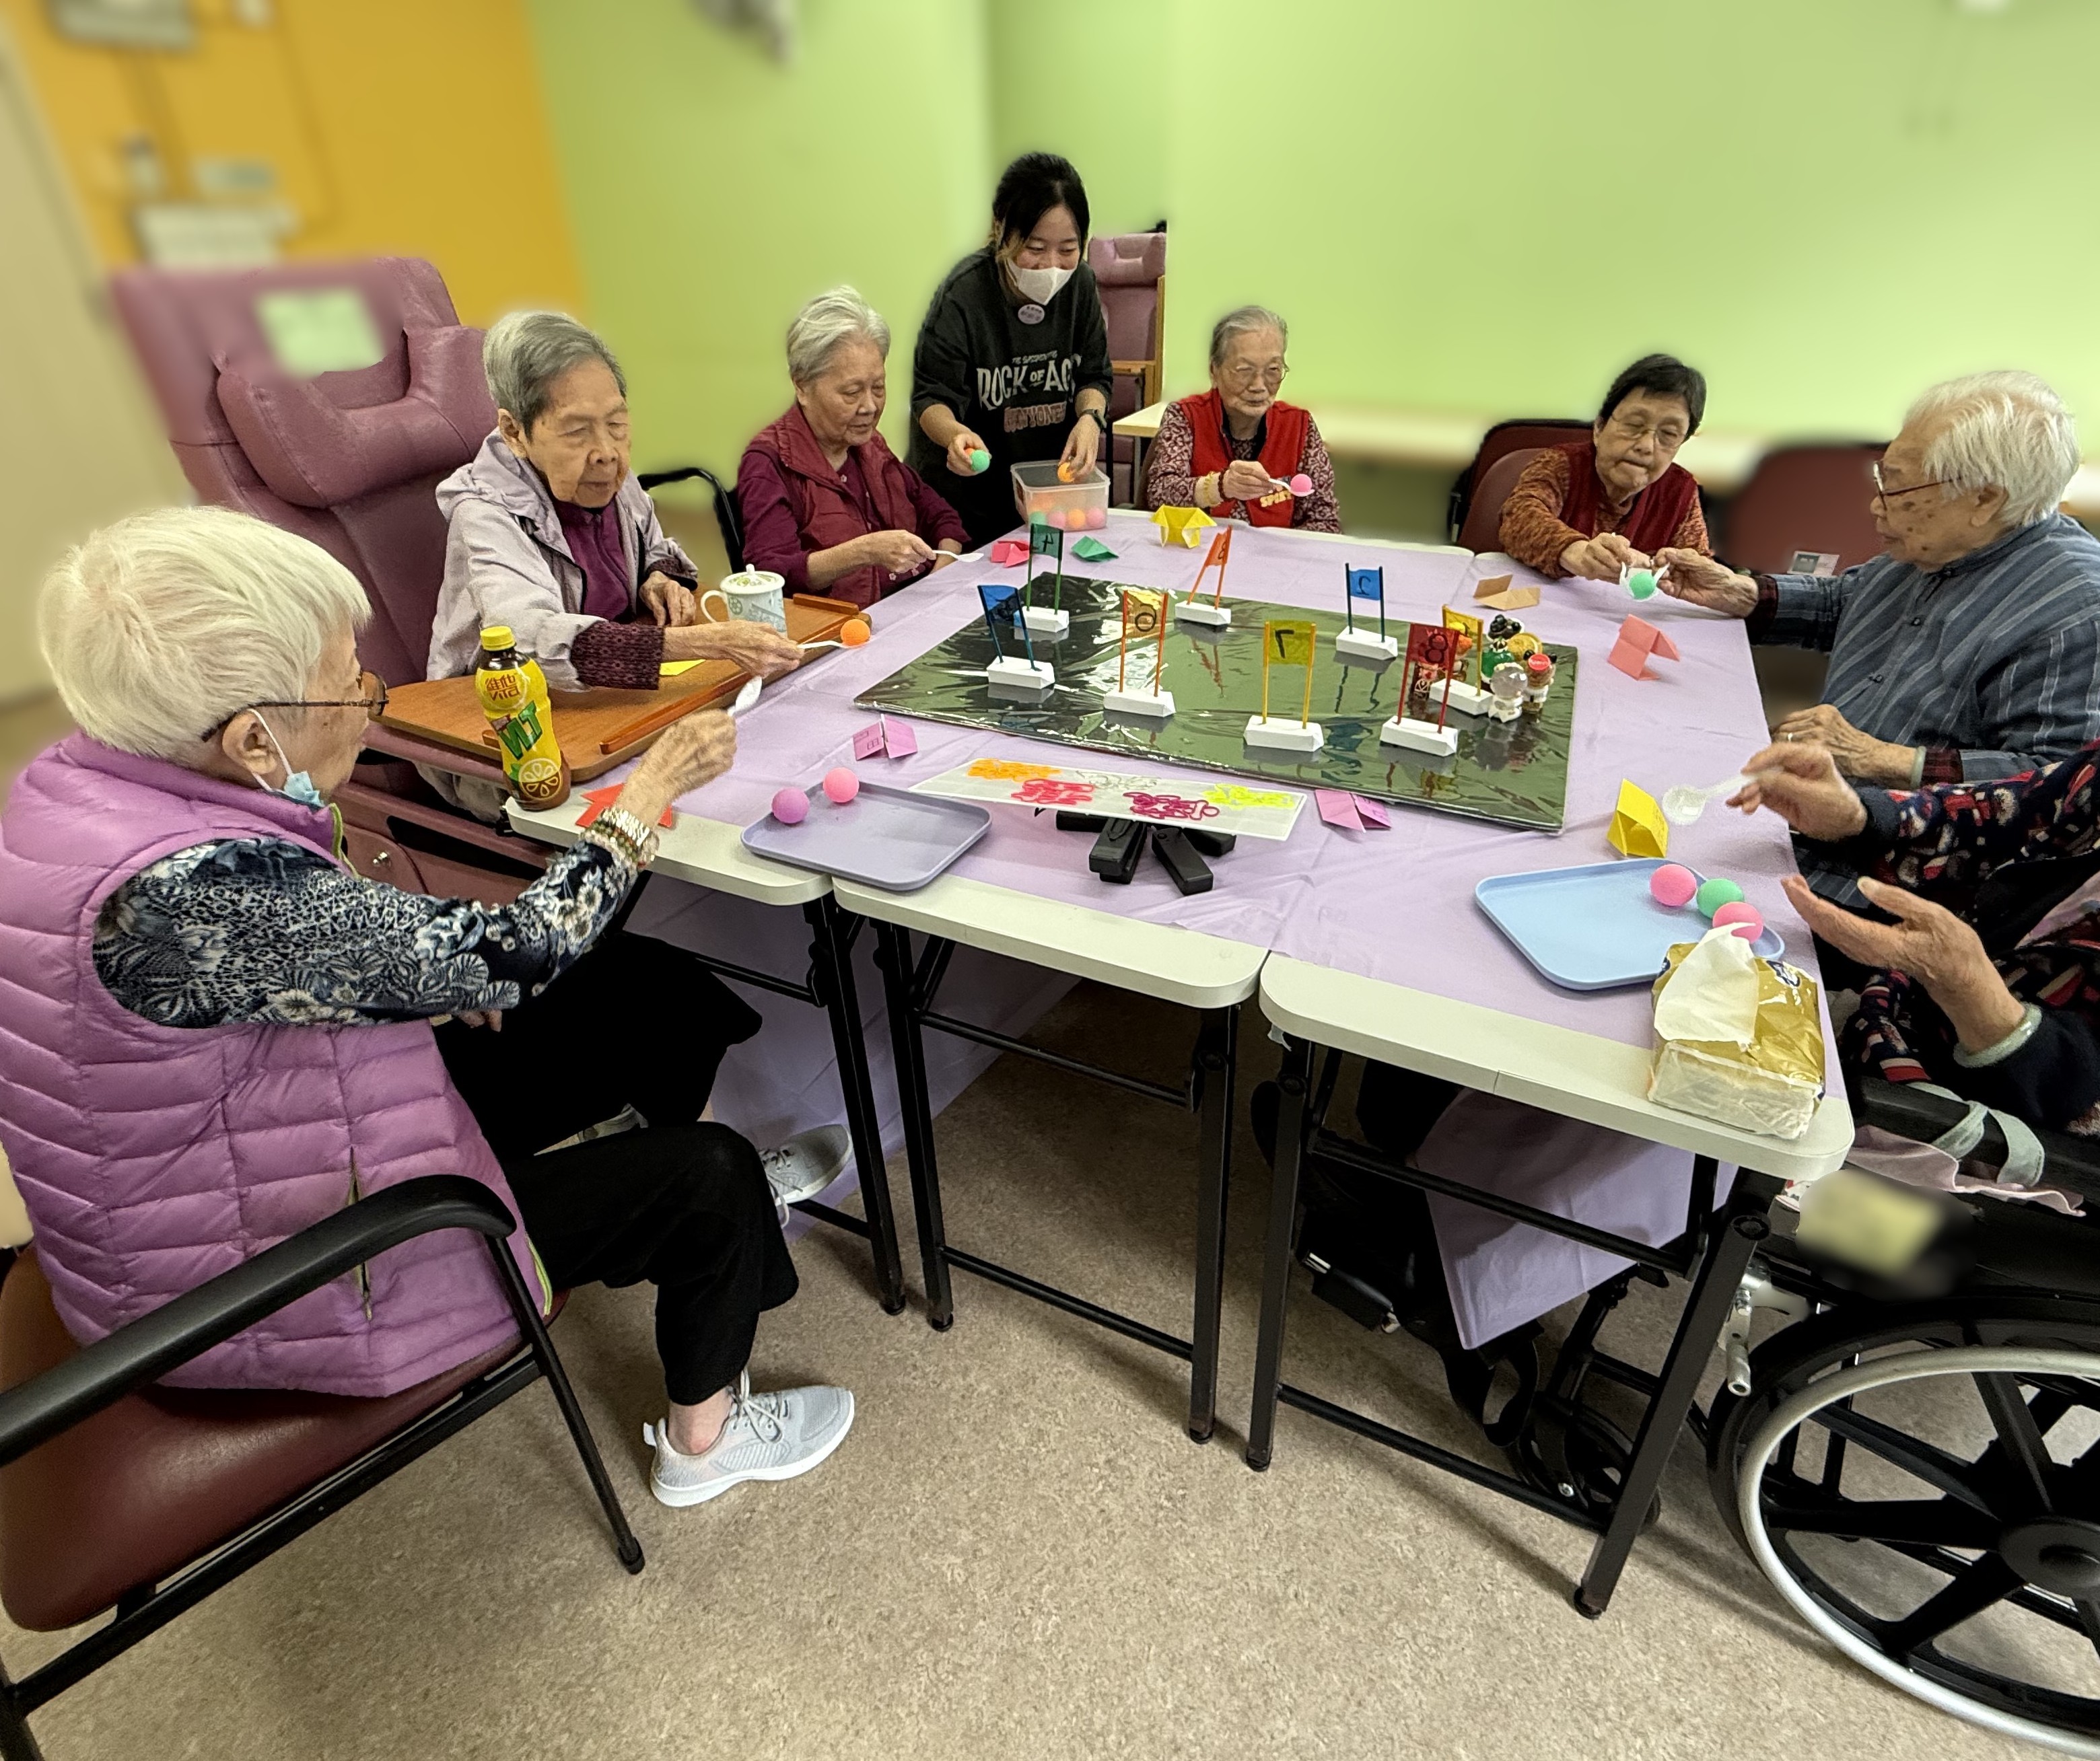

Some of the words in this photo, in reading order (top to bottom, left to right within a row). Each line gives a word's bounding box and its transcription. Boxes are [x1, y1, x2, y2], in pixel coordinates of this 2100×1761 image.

[976, 365, 1028, 410] ROCK
[1030, 369, 1045, 384] OF
[497, 700, 543, 761] VLT
